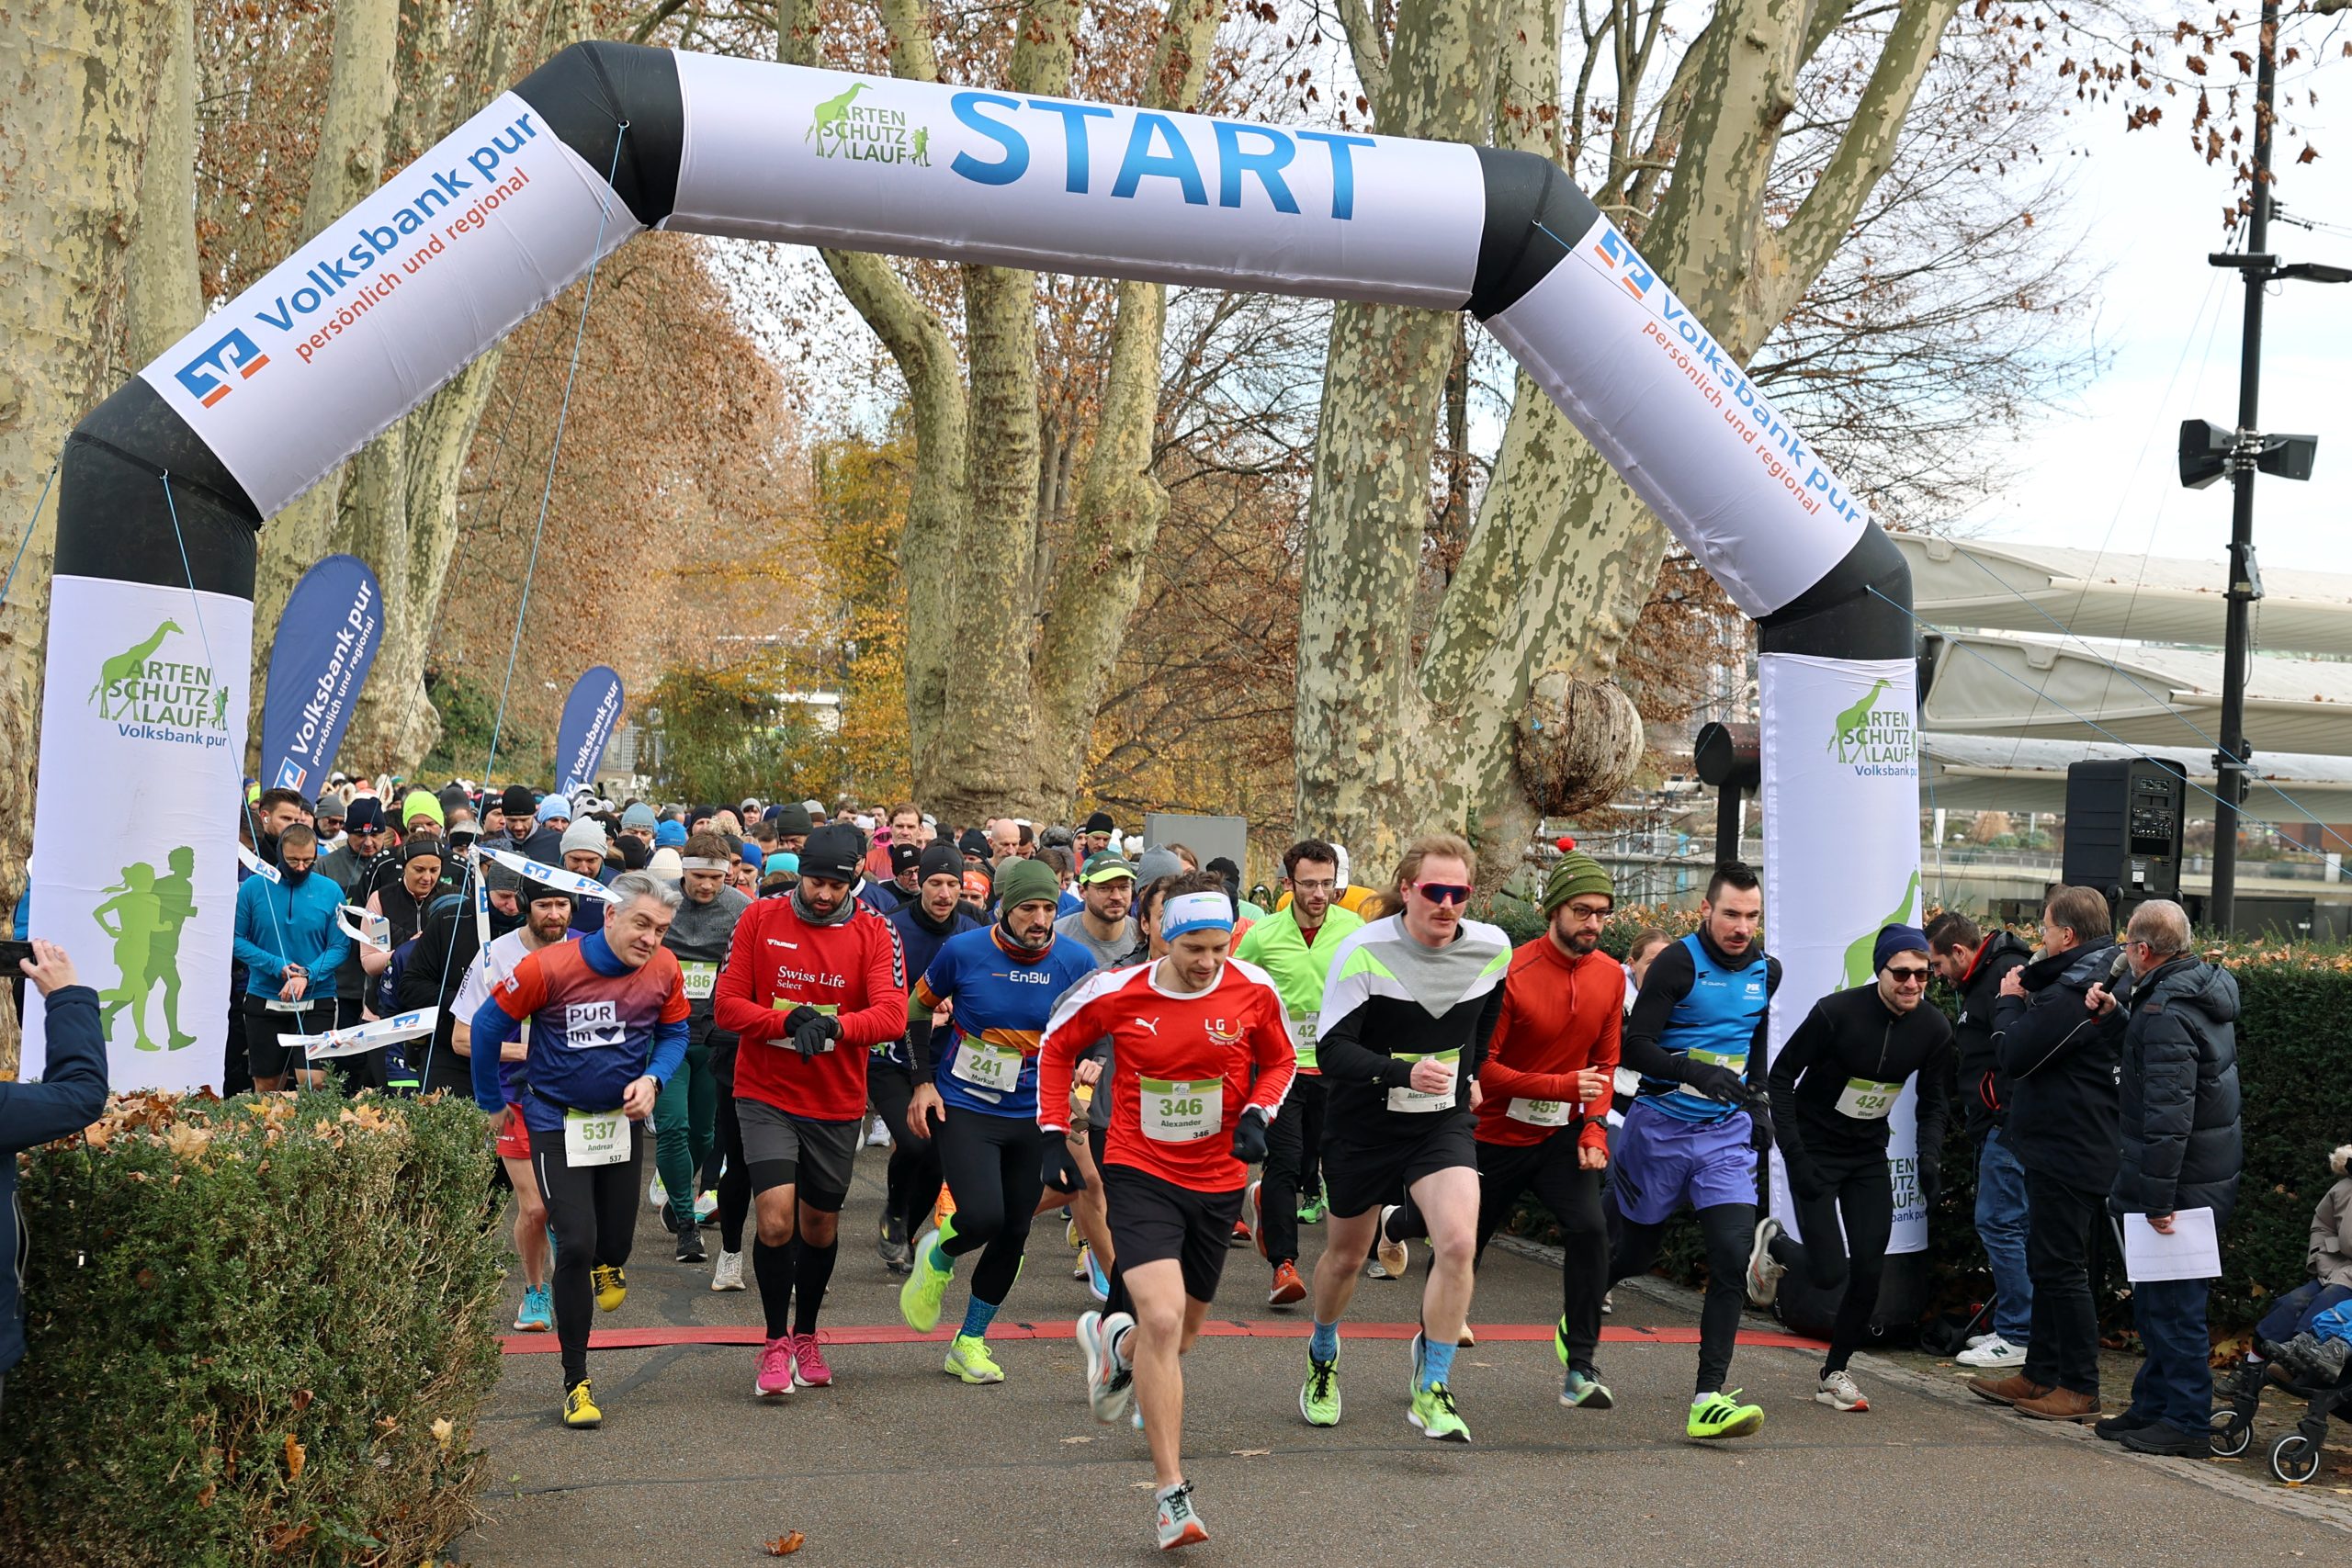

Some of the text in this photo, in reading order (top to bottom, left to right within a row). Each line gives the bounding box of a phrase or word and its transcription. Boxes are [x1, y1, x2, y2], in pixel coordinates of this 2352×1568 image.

[835, 105, 906, 127] ARTEN
[822, 119, 907, 145] SCHUTZ
[852, 141, 907, 164] LAUF
[950, 92, 1376, 220] START
[254, 112, 537, 332] Volksbank pur
[295, 166, 530, 364] persönlich und regional
[1663, 293, 1860, 524] Volksbank pur
[1643, 321, 1822, 516] persönlich und regional
[125, 659, 211, 686] ARTEN
[290, 580, 372, 755] Volksbank pur
[108, 678, 209, 707] SCHUTZ
[311, 615, 375, 767] persönlich und regional
[142, 704, 208, 728] LAUF
[1856, 711, 1909, 728] ARTEN
[118, 723, 227, 749] Volksbank pur
[571, 681, 619, 776] Volksbank pur
[1844, 728, 1909, 745] SCHUTZ
[1871, 747, 1910, 763] LAUF
[1855, 764, 1909, 776] Volksbank
[774, 938, 798, 950] hummel
[684, 975, 711, 987] 486
[776, 979, 803, 990] Select
[777, 965, 846, 988] Swiss Life
[1009, 970, 1050, 985] EnBW
[570, 1006, 612, 1022] PUR
[1204, 1018, 1226, 1031] LG
[1297, 1024, 1317, 1037] 42
[969, 1054, 1002, 1077] 241
[970, 1074, 995, 1085] Markus
[1159, 1098, 1204, 1116] 346
[1434, 1101, 1447, 1110] 132
[1528, 1100, 1560, 1113] 459
[1855, 1094, 1887, 1109] 424
[582, 1121, 616, 1140] 537
[1160, 1119, 1202, 1127] Alexander
[1193, 1129, 1210, 1139] 346
[1887, 1157, 1915, 1174] TEN
[1891, 1175, 1915, 1191] UTZ
[1892, 1191, 1915, 1209] UF
